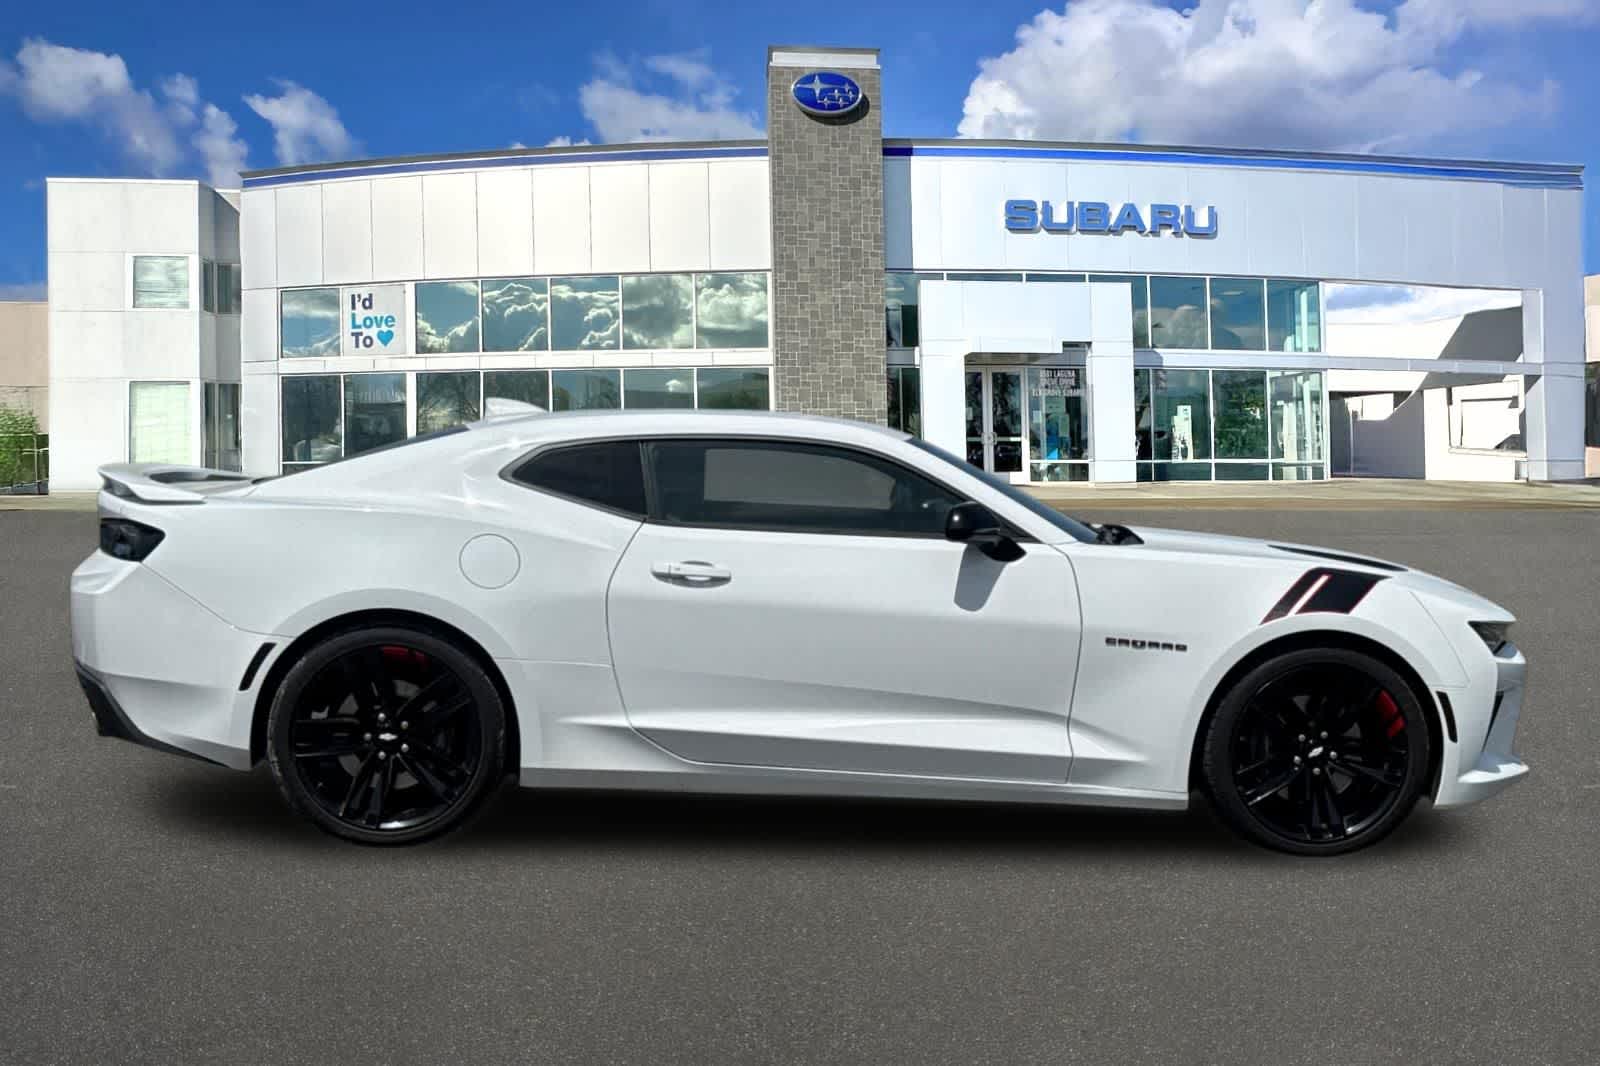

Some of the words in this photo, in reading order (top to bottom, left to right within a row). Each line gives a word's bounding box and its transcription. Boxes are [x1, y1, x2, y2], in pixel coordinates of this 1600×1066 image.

[1005, 199, 1218, 238] SUBARU
[351, 293, 373, 311] I'd
[351, 312, 396, 329] Love
[351, 331, 374, 349] To
